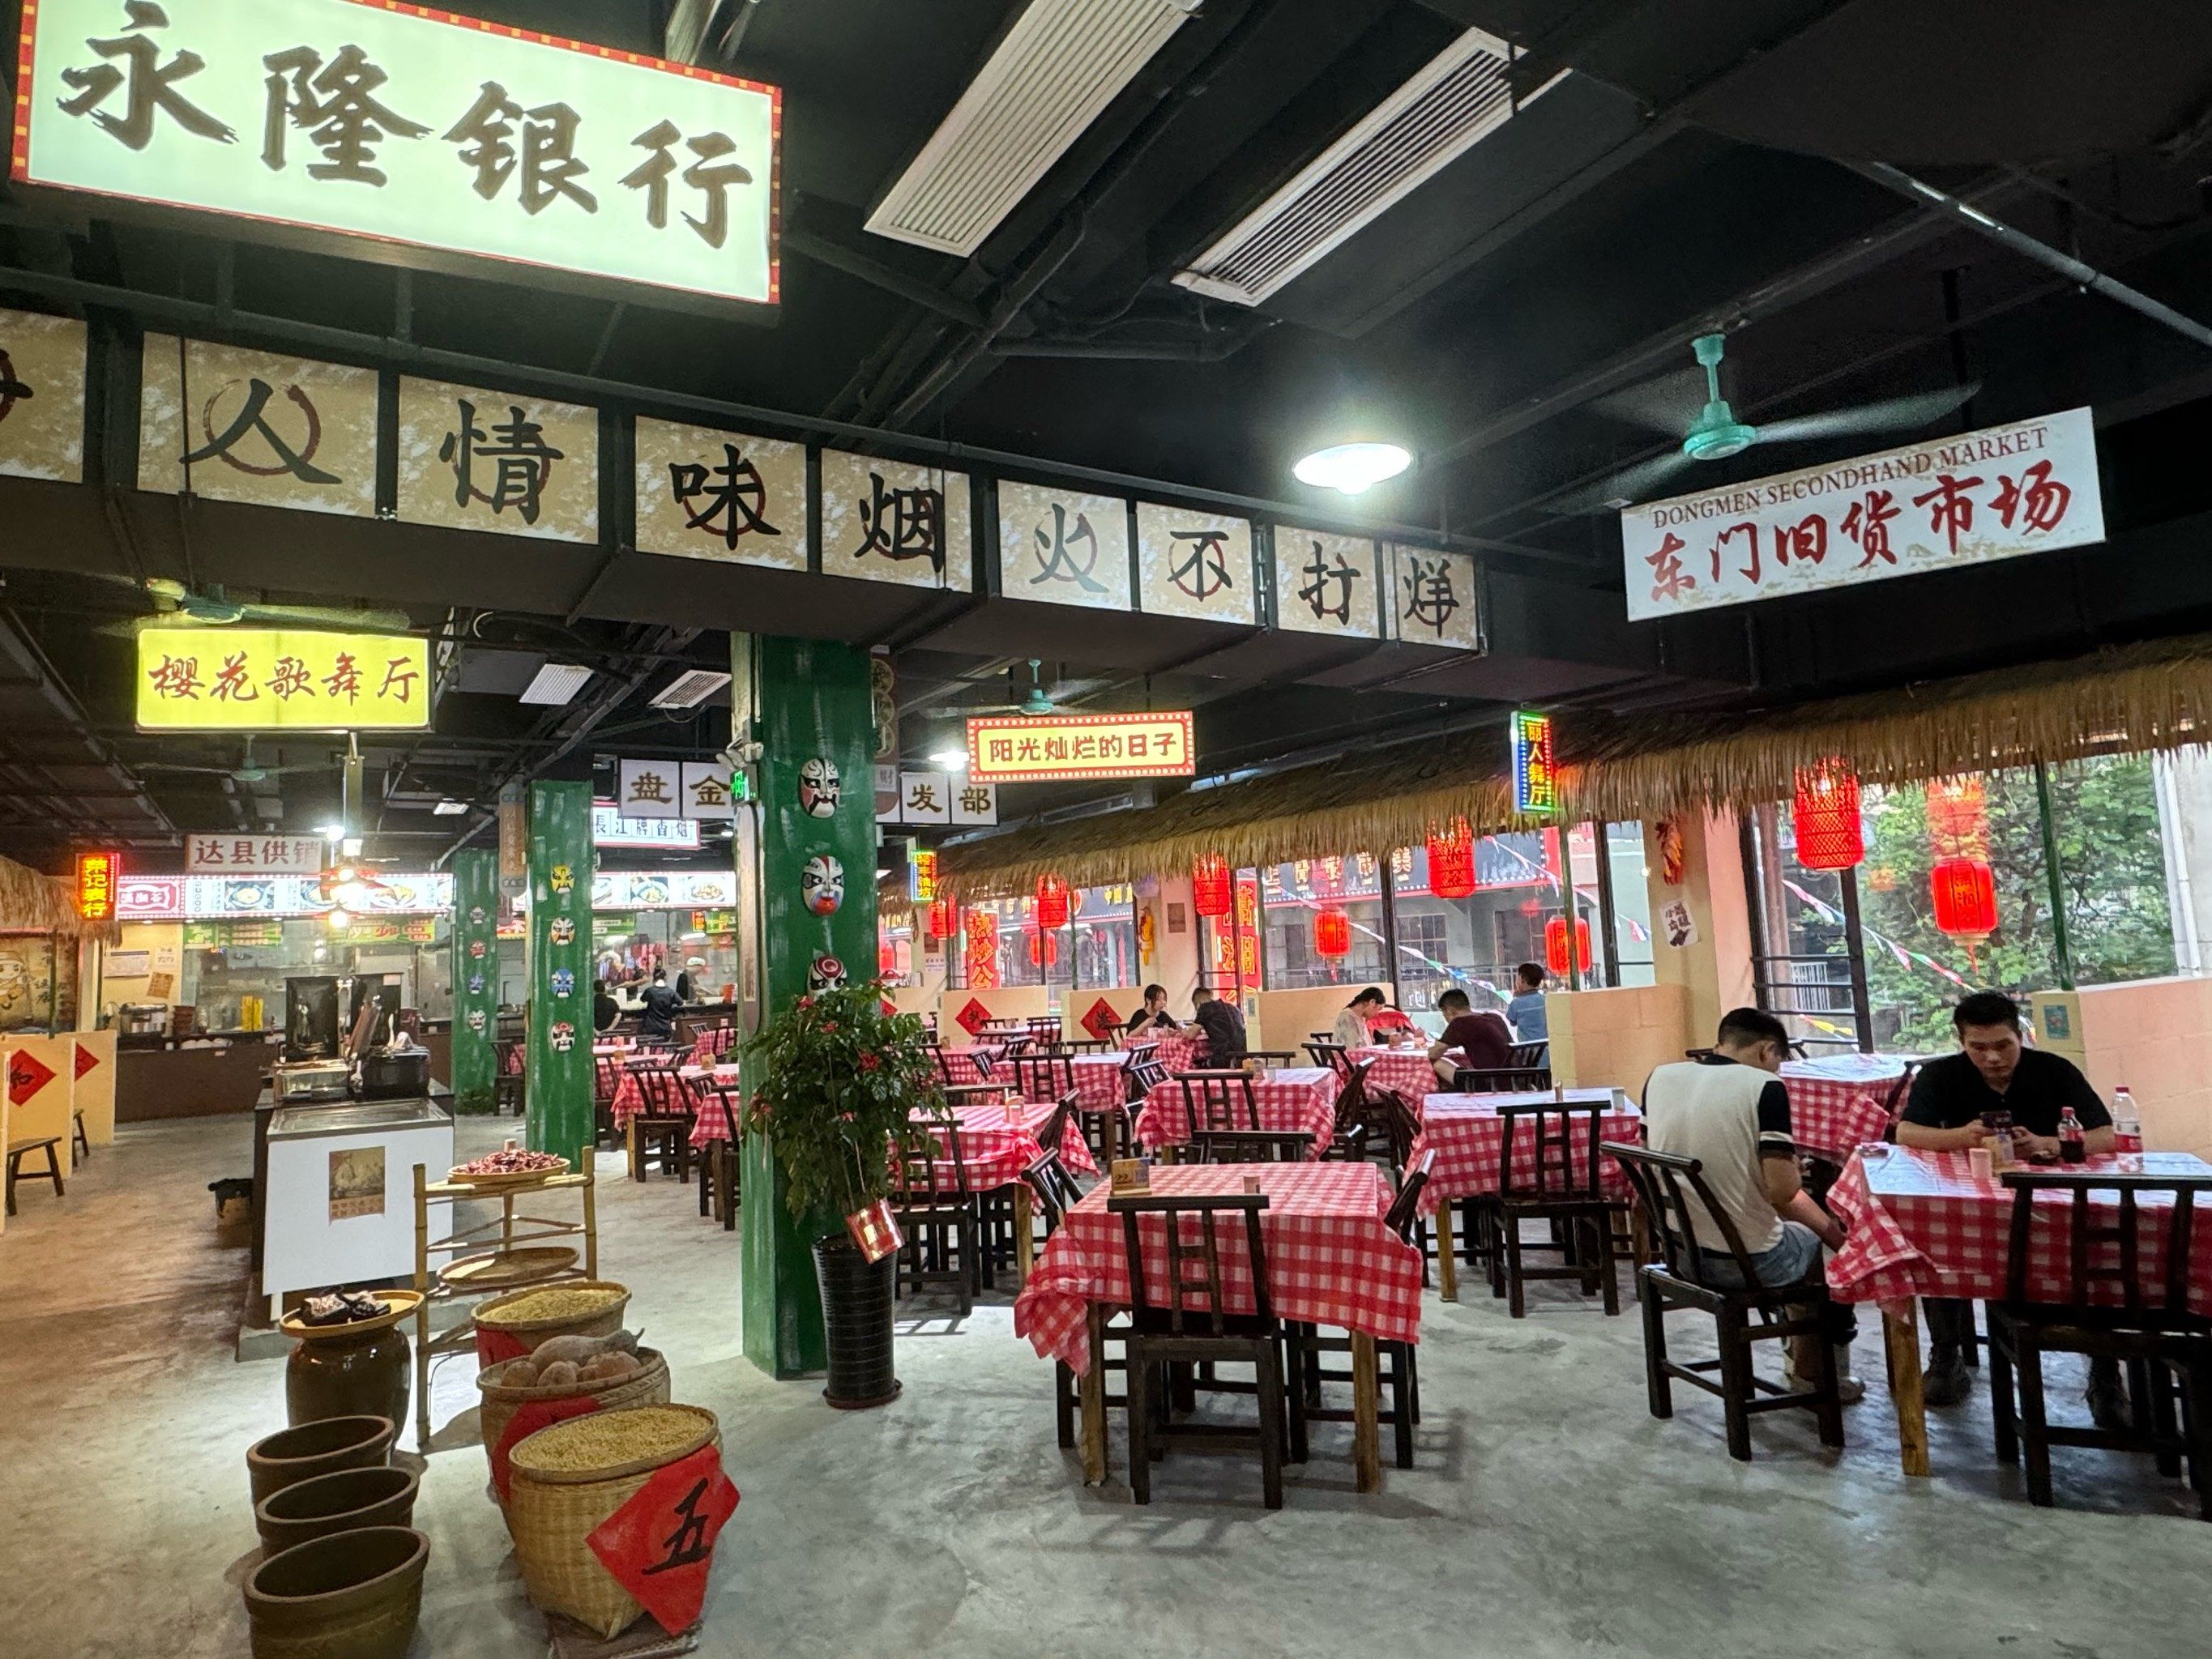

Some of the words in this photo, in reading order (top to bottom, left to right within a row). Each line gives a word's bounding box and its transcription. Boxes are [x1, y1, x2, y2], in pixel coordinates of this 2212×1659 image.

[57, 0, 752, 249] 永隆银行
[1654, 489, 1761, 528] DONGMEN
[1767, 453, 1932, 505] SECONDHAND
[1939, 427, 2048, 467] MARKET
[1644, 459, 2071, 601] 东门旧货市场
[148, 651, 419, 706] 樱花歌舞厅
[989, 732, 1176, 763] 阳光灿烂的日子
[1527, 722, 1545, 804] 丽人舞厅
[194, 839, 319, 865] 达县供销
[642, 1478, 711, 1576] 五
